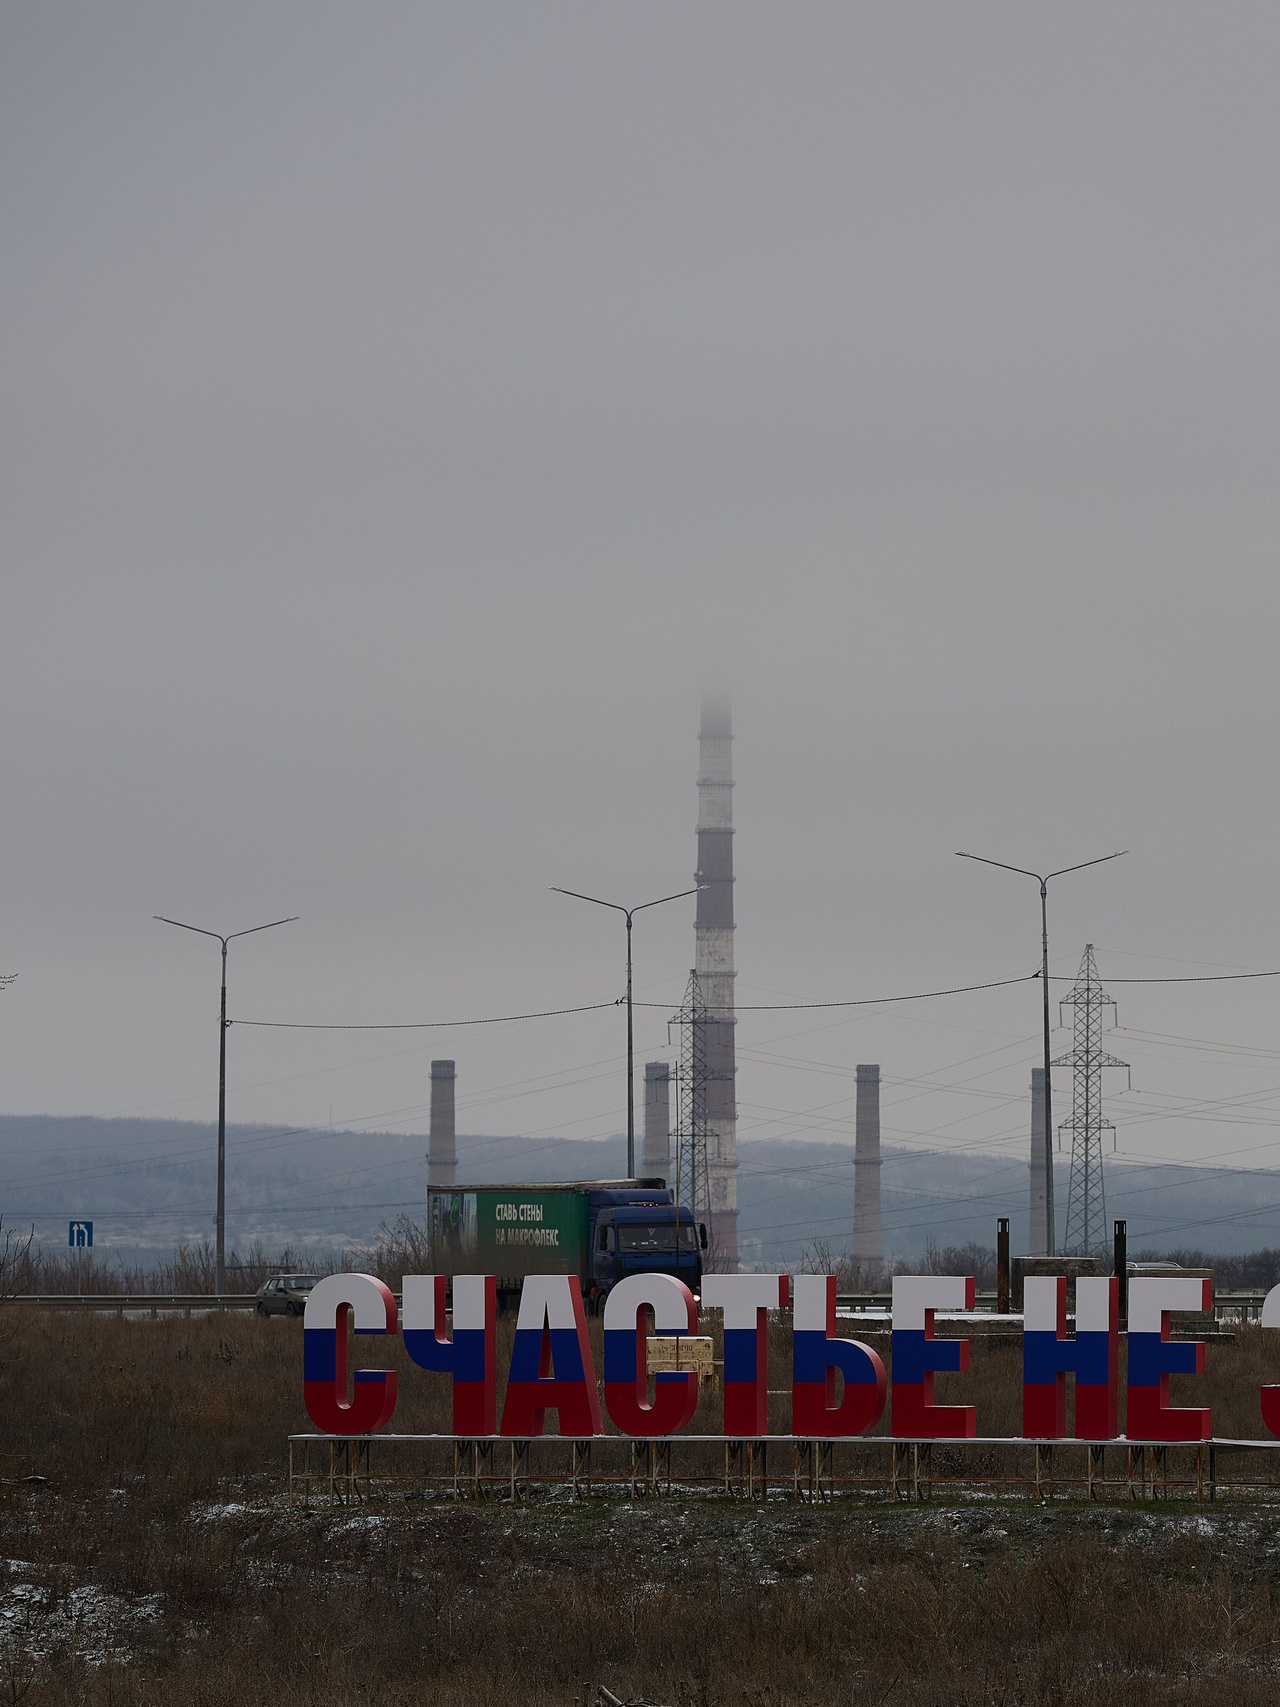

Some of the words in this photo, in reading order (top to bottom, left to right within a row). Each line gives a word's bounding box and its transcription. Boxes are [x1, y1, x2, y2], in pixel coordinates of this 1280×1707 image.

[495, 1203, 518, 1221] СТАВЬ
[518, 1204, 543, 1222] СТЕНЫ
[495, 1228, 506, 1245] НА
[507, 1227, 560, 1247] МАКРОФЛЕКС
[303, 1272, 977, 1438] СЧАСТЬЕ
[1022, 1275, 1212, 1441] НЕ
